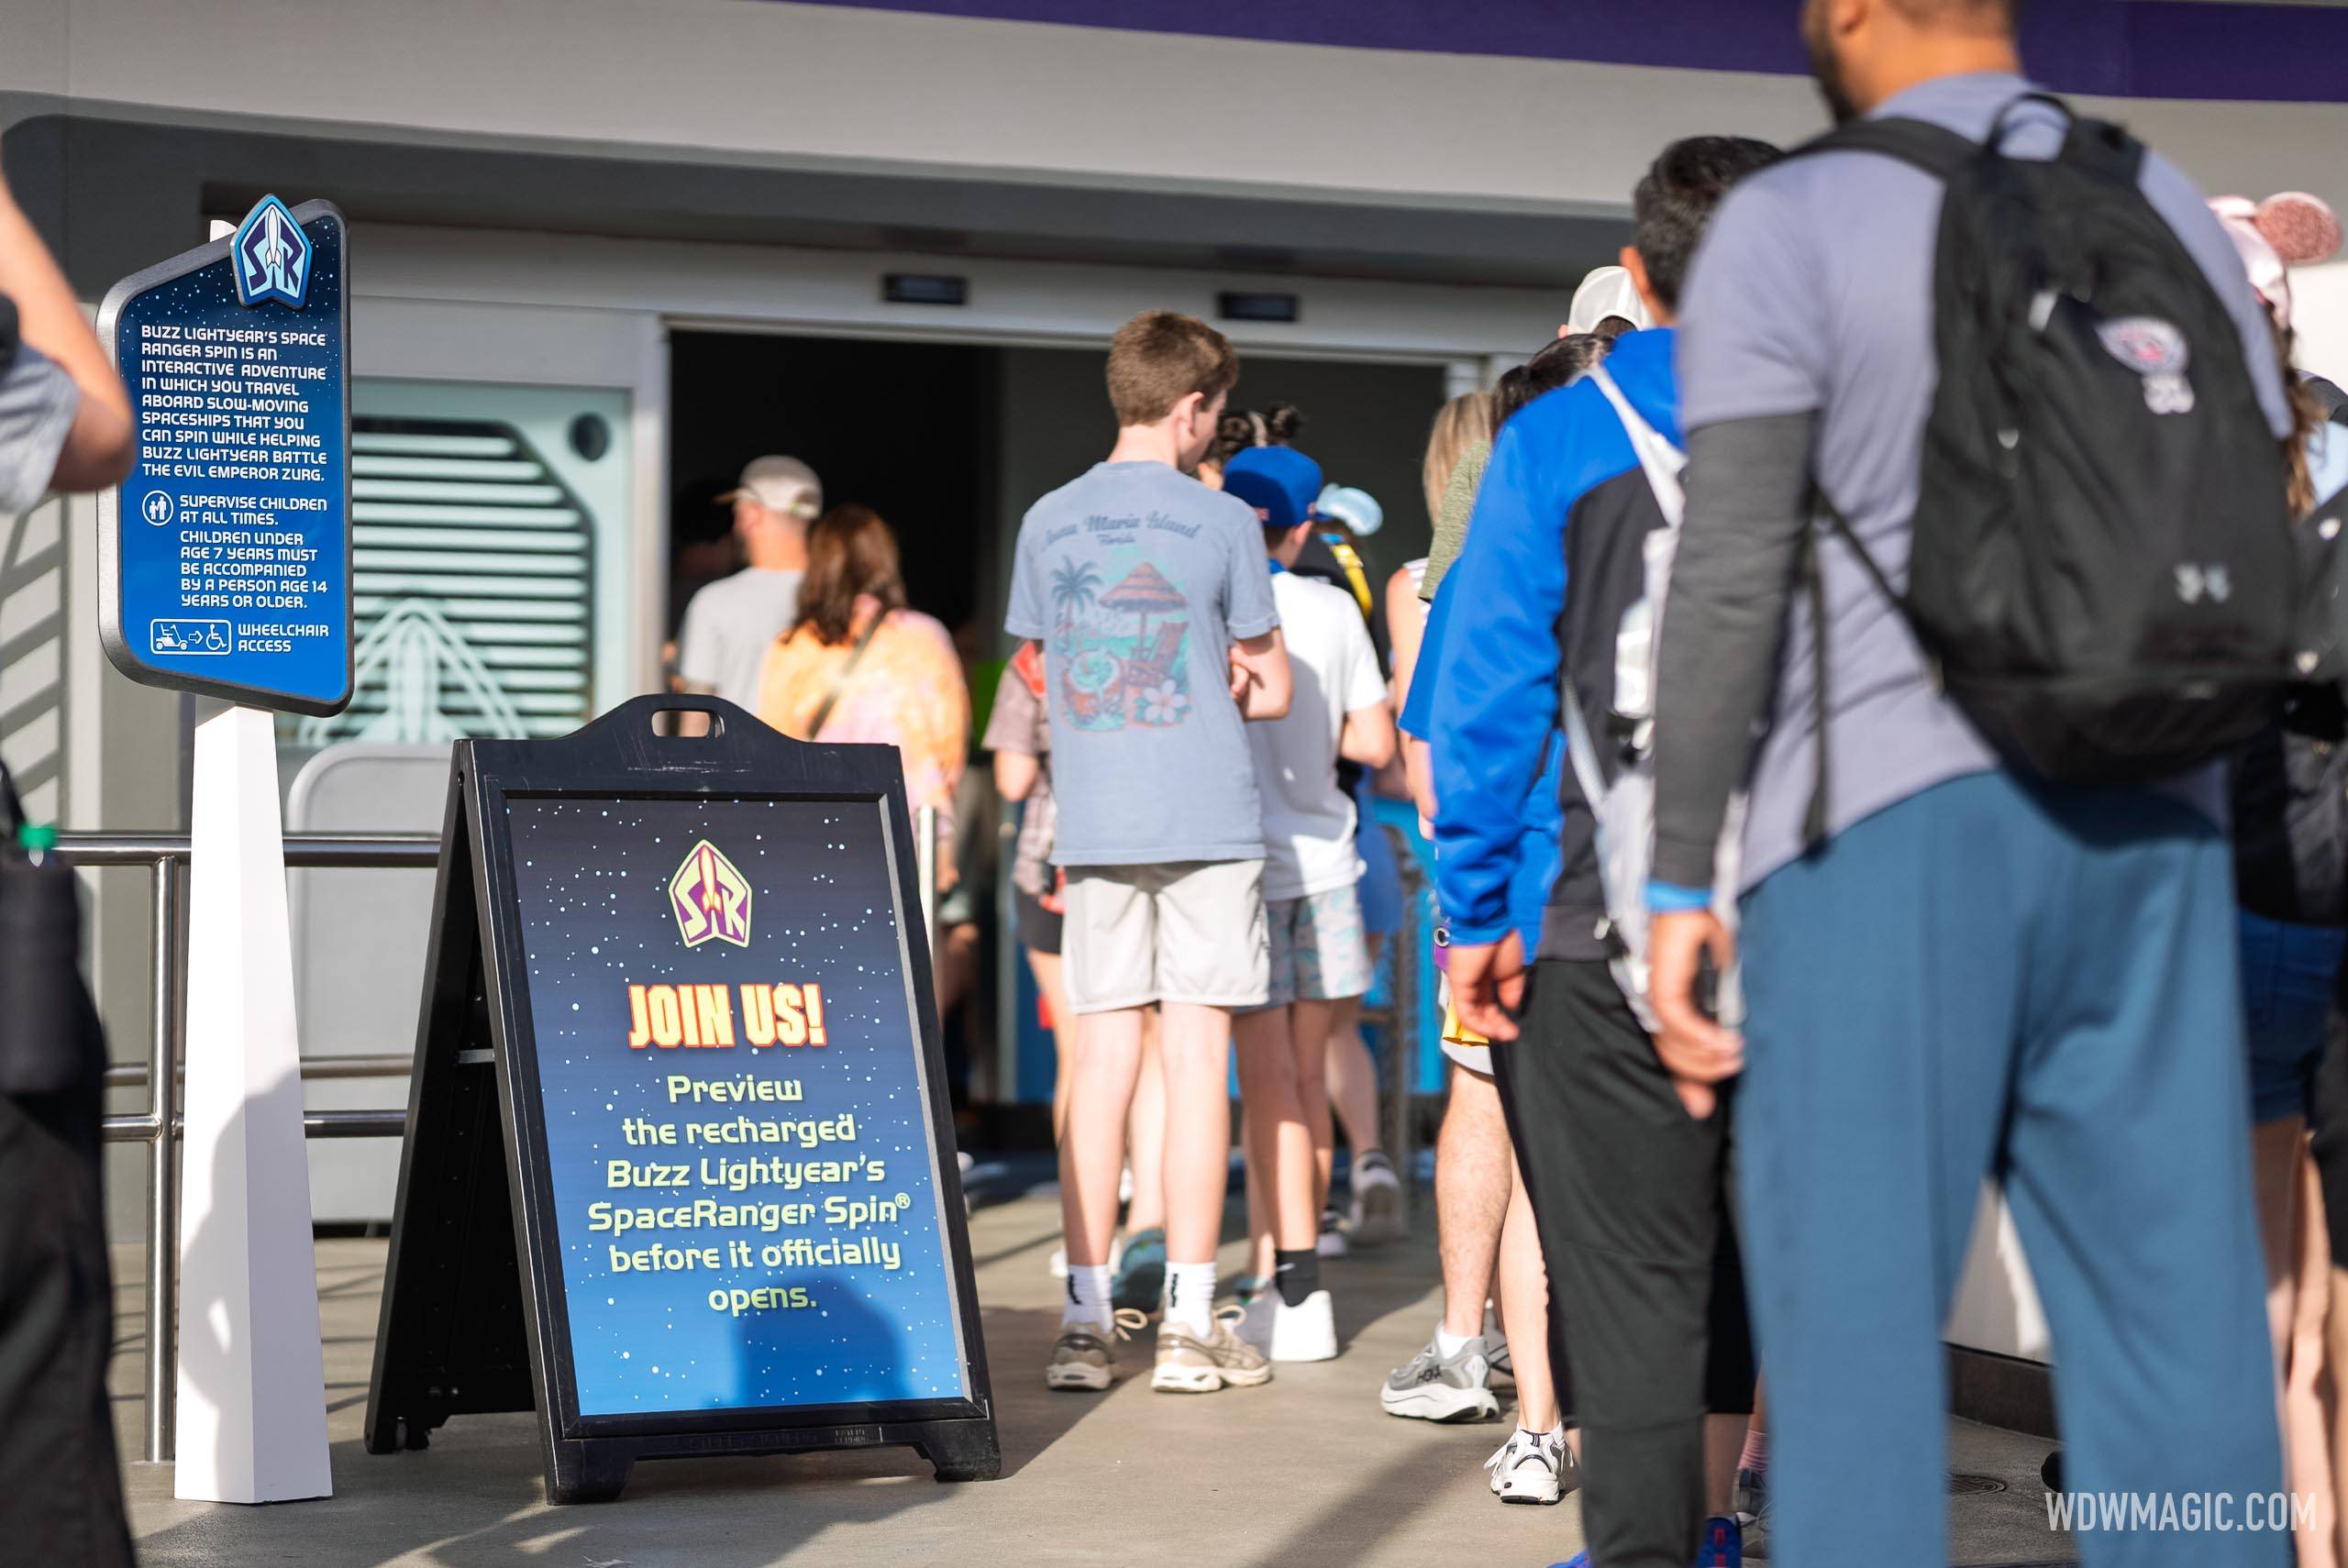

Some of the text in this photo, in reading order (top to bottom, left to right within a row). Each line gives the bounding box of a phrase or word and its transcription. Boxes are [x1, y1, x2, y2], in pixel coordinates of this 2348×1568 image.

[141, 325, 327, 347] BUZZ LIGHTYEAR'S SPACE
[141, 342, 278, 361] RANGER SPIN IS AN
[141, 359, 327, 381] INTERACTIVE ADVENTURE
[141, 377, 300, 396] IN WHICH YOU TRAVEL
[142, 394, 309, 414] ABOARD SLOW-MOVING
[141, 411, 305, 430] SPACESHIPS THAT YOU
[141, 428, 321, 447] CAN SPIN WHILE HELPING
[142, 446, 327, 465] BUZZ LIGHTYEAR BATTLE
[141, 463, 325, 481] THE EVIL EMPEROR ZURG.
[180, 494, 327, 511] SUPERVISE CHILDREN
[180, 511, 279, 525] AT ALL TIMES.
[180, 530, 304, 546] CHILDREN UNDER
[181, 546, 318, 561] AGE 7 YEARS MUST
[181, 562, 307, 577] BE ACCOMPANIED
[181, 578, 328, 593] BY A PERSON AGE 14
[181, 593, 307, 609] YEARS OR OLDER.
[238, 624, 329, 637] WHEELCHAIR
[238, 639, 292, 653] ACCESS
[628, 983, 827, 1048] JOIN US!
[667, 1074, 803, 1102] Preview
[623, 1114, 857, 1148] the recharged
[606, 1154, 885, 1190] Buzz Lightyear's
[588, 1199, 815, 1236] SpaceRanger
[609, 1236, 902, 1273] before it officially
[708, 1286, 817, 1317] opens.
